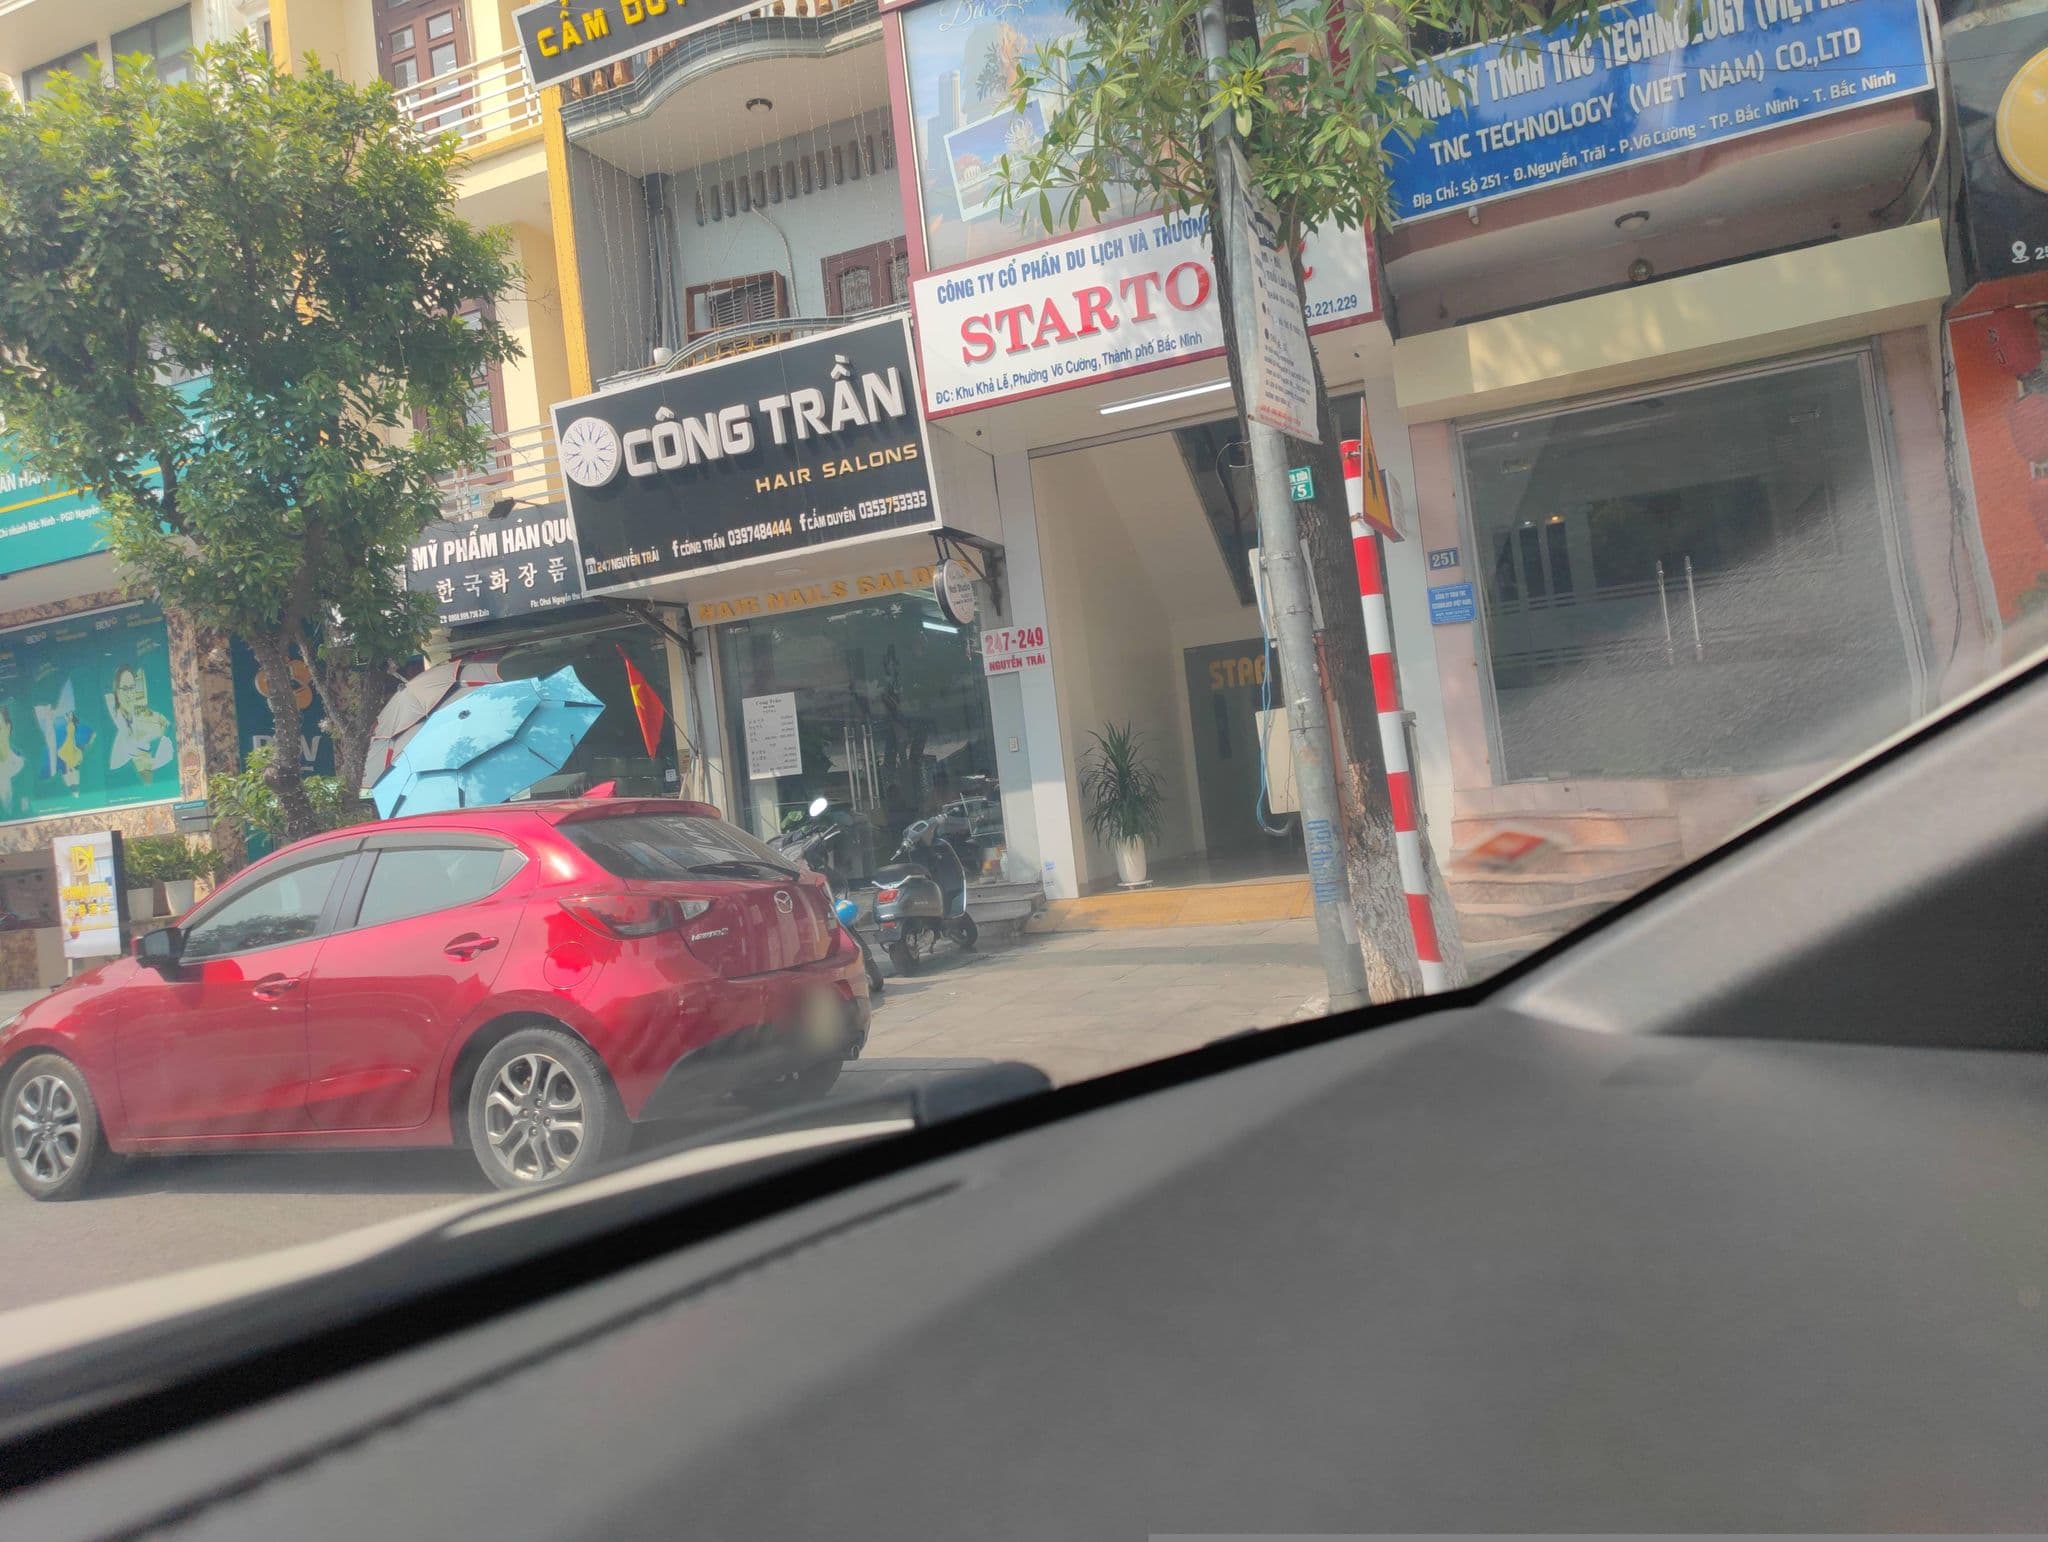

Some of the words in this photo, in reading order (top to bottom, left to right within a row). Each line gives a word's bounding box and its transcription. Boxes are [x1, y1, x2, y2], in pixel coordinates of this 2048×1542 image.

[620, 0, 686, 25] DU
[1395, 74, 1452, 120] ÔNG
[1548, 33, 1595, 84] TNC
[1600, 0, 1746, 70] TECHNOOGY
[1430, 133, 1472, 166] TNC
[1476, 92, 1615, 153] TECHNOLOGY
[1629, 73, 1687, 114] (VIET
[1699, 50, 1765, 92] NAM)
[1775, 27, 1862, 72] CO.,LTD
[1413, 194, 1433, 209] Địa
[1462, 177, 1479, 195] Số
[1480, 173, 1501, 190] 251
[1580, 144, 1606, 163] Trãi
[1735, 104, 1761, 124] Bắc
[1765, 96, 1800, 116] Ninh
[1830, 80, 1857, 99] Bắc
[1861, 71, 1897, 91] Ninh
[937, 279, 974, 305] CÔNG
[977, 273, 995, 295] TY
[999, 257, 1018, 289] CỔ
[1021, 251, 1062, 282] PHẦN
[1066, 251, 1087, 269] DU
[1091, 239, 1125, 267] LỊCH
[1129, 228, 1149, 254] VÀ
[960, 260, 1213, 366] STARTO
[956, 384, 975, 401] Khu
[976, 377, 995, 397] Khả
[1102, 347, 1133, 366] Thành
[1157, 330, 1177, 353] Bắc
[1180, 331, 1203, 349] Ninh
[623, 404, 755, 478] CÔNG
[758, 353, 908, 446] TRẦN
[755, 467, 813, 494] HAIR
[822, 443, 919, 479] SALONS
[411, 538, 438, 572] MỸ
[443, 524, 499, 566] PHẨM
[680, 539, 703, 556] CÔNG
[728, 518, 793, 547] 0397484444
[828, 507, 857, 526] DUYÊN
[858, 490, 928, 520] 0353753333
[436, 555, 568, 604] 한국화장품
[1431, 551, 1457, 568] 251
[985, 626, 1044, 656] 247-249
